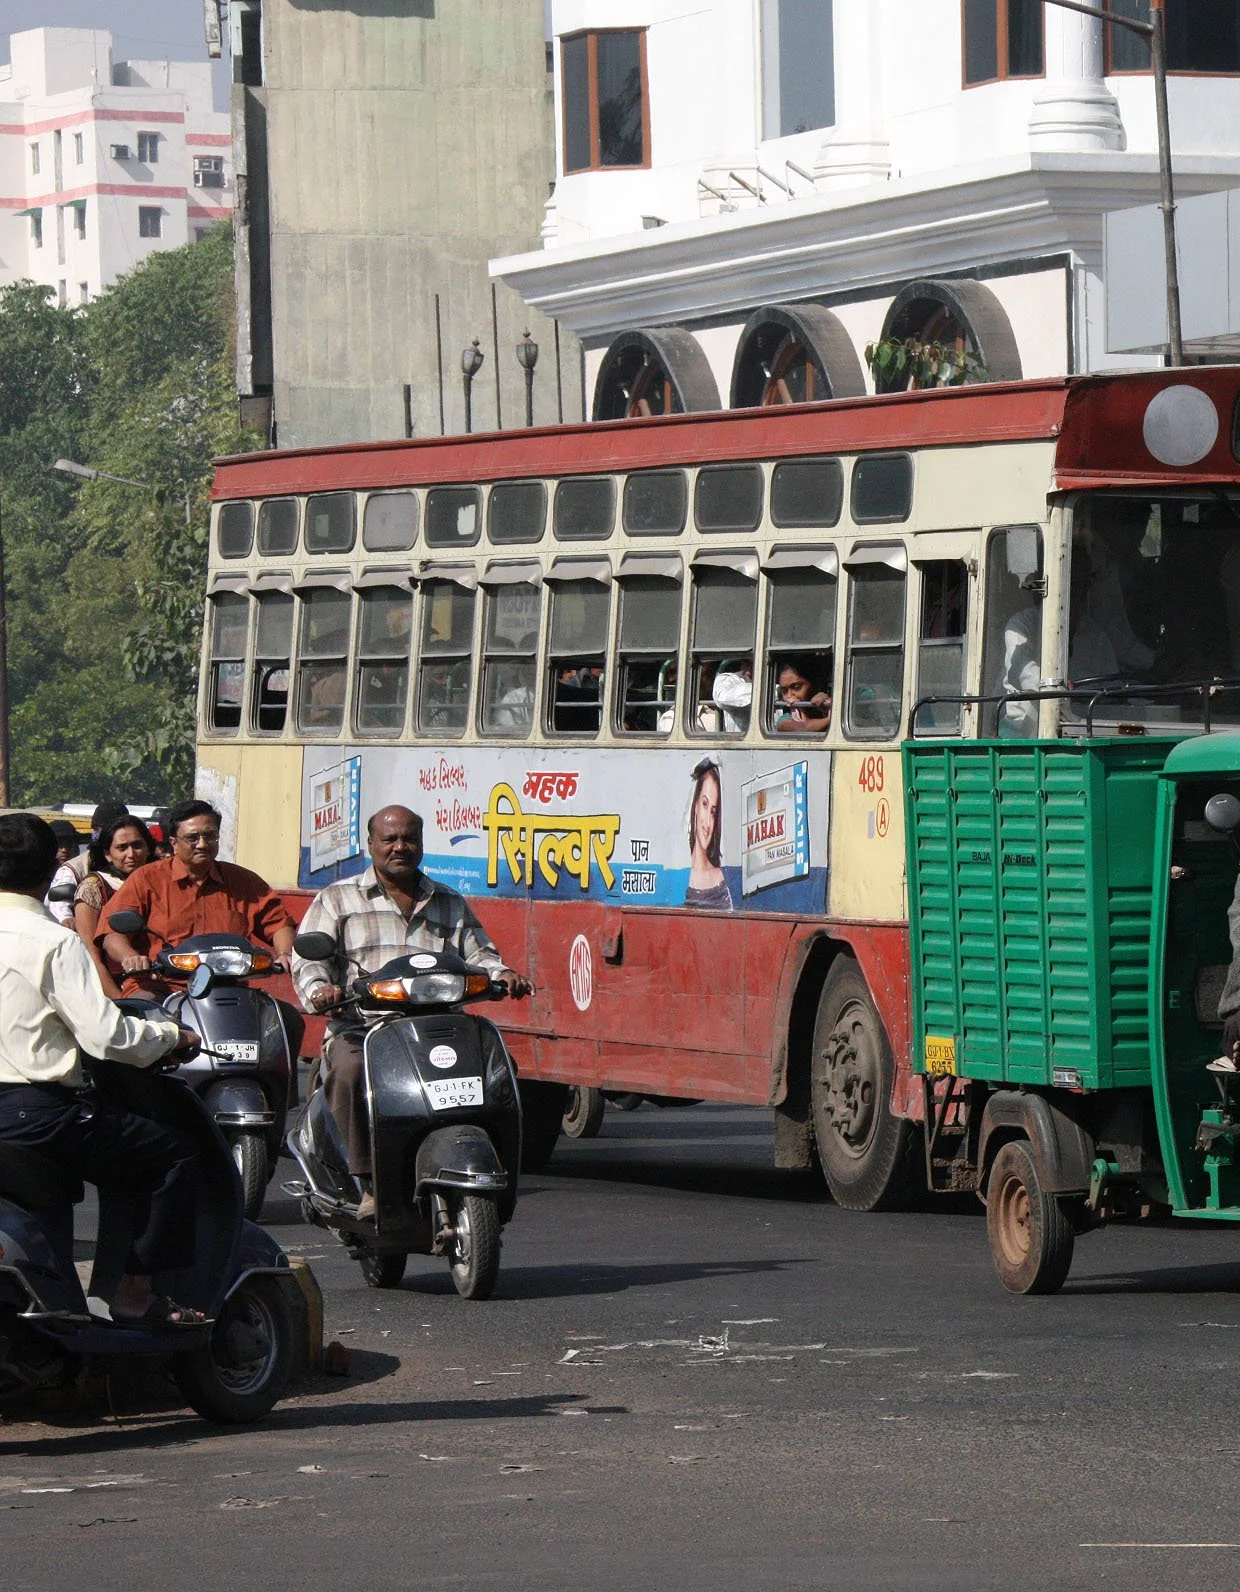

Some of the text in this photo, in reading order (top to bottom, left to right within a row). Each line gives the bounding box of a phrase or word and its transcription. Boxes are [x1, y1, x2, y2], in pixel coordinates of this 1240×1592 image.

[522, 771, 580, 804] महक
[858, 755, 885, 793] 489
[314, 802, 343, 831] MAHA
[747, 814, 785, 848] MAHAK
[796, 774, 804, 865] SILVER
[482, 781, 622, 893] सिल्वर
[630, 839, 650, 863] पान
[621, 869, 656, 894] मसाला
[438, 1093, 476, 1106] 9557
